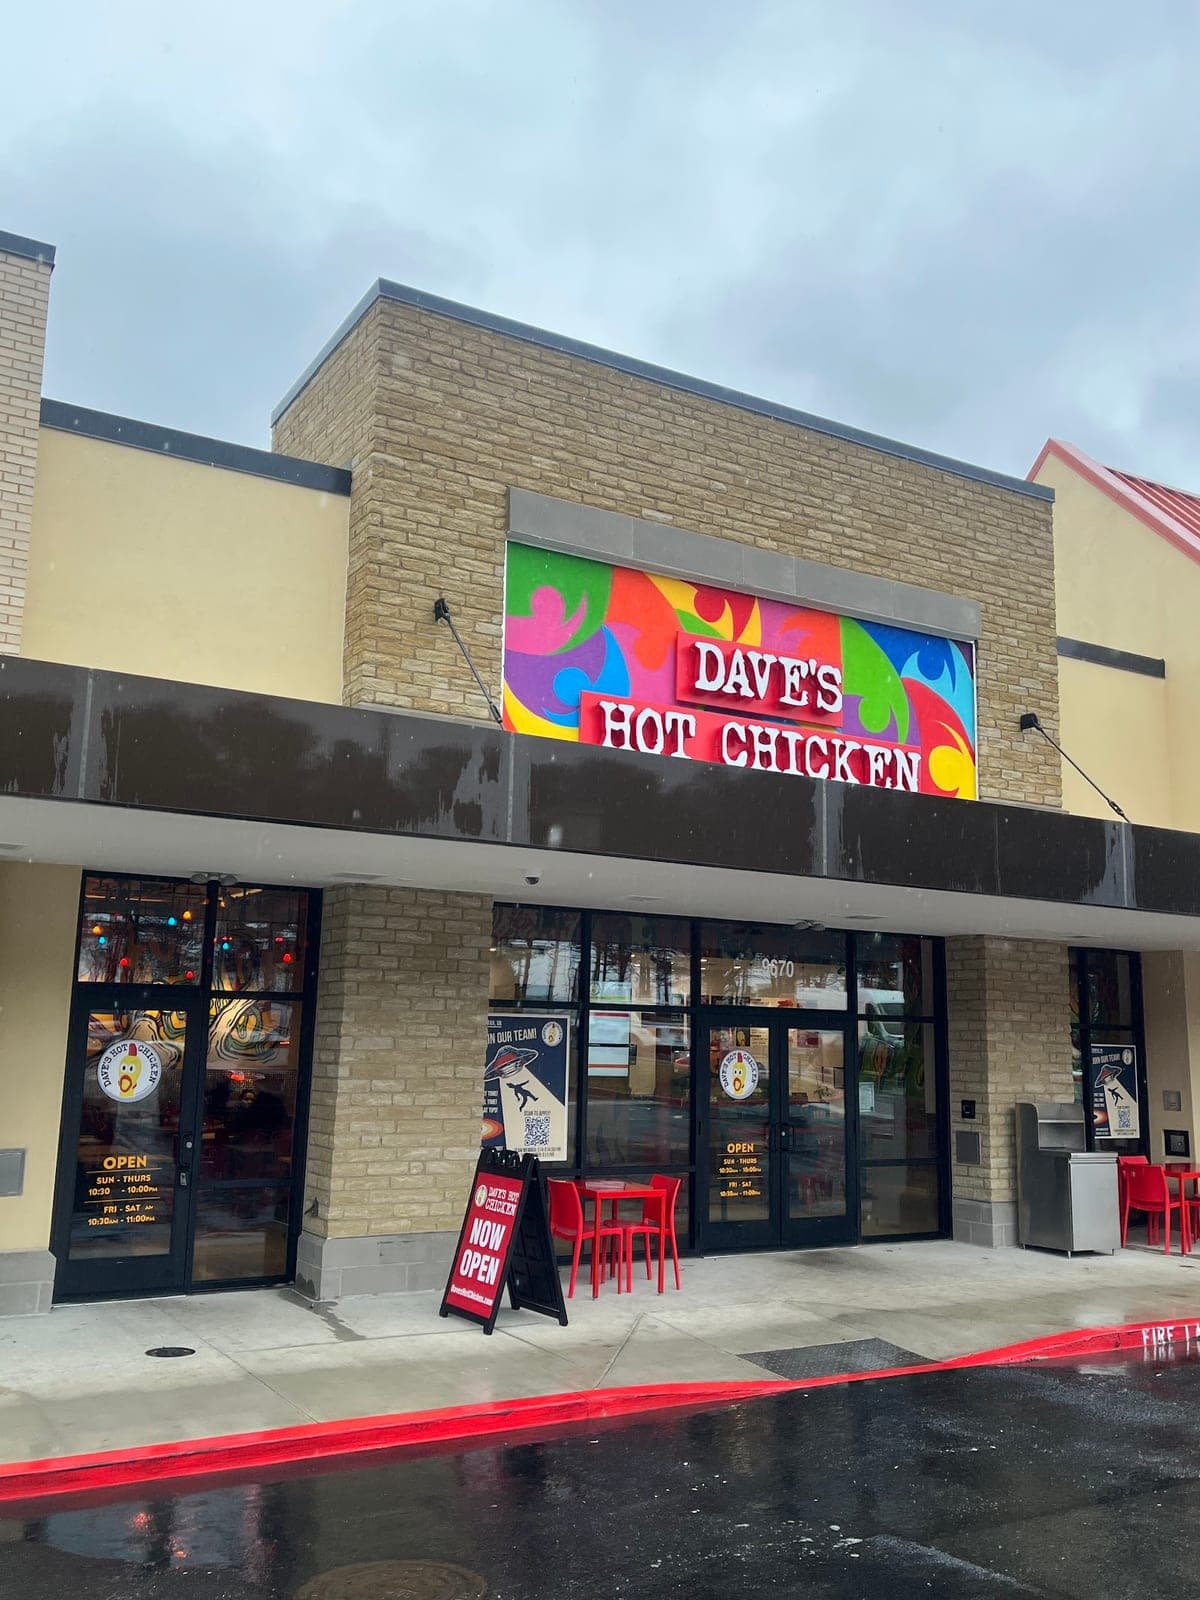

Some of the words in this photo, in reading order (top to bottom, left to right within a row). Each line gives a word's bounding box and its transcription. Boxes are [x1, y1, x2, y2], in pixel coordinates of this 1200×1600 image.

[694, 641, 843, 713] DAVE'S
[599, 701, 696, 760] HOT
[721, 721, 922, 793] CHICKEN
[762, 957, 794, 978] 9670
[497, 1030, 512, 1043] OUR
[513, 1027, 537, 1042] TEAM!
[101, 1056, 112, 1088] DAVE'S
[110, 1043, 128, 1057] HOT
[138, 1044, 159, 1086] CHICKEN
[727, 1143, 754, 1153] OPEN
[103, 1154, 148, 1170] OPEN
[96, 1175, 115, 1185] SUN
[122, 1174, 151, 1183] THURS
[88, 1187, 111, 1196] 10:30
[103, 1205, 118, 1214] FRI
[124, 1204, 141, 1213] SAT
[485, 1198, 517, 1216] CHICKEN
[469, 1217, 507, 1251] NOW
[459, 1248, 500, 1286] OPEN
[1142, 1325, 1174, 1345] FIRE
